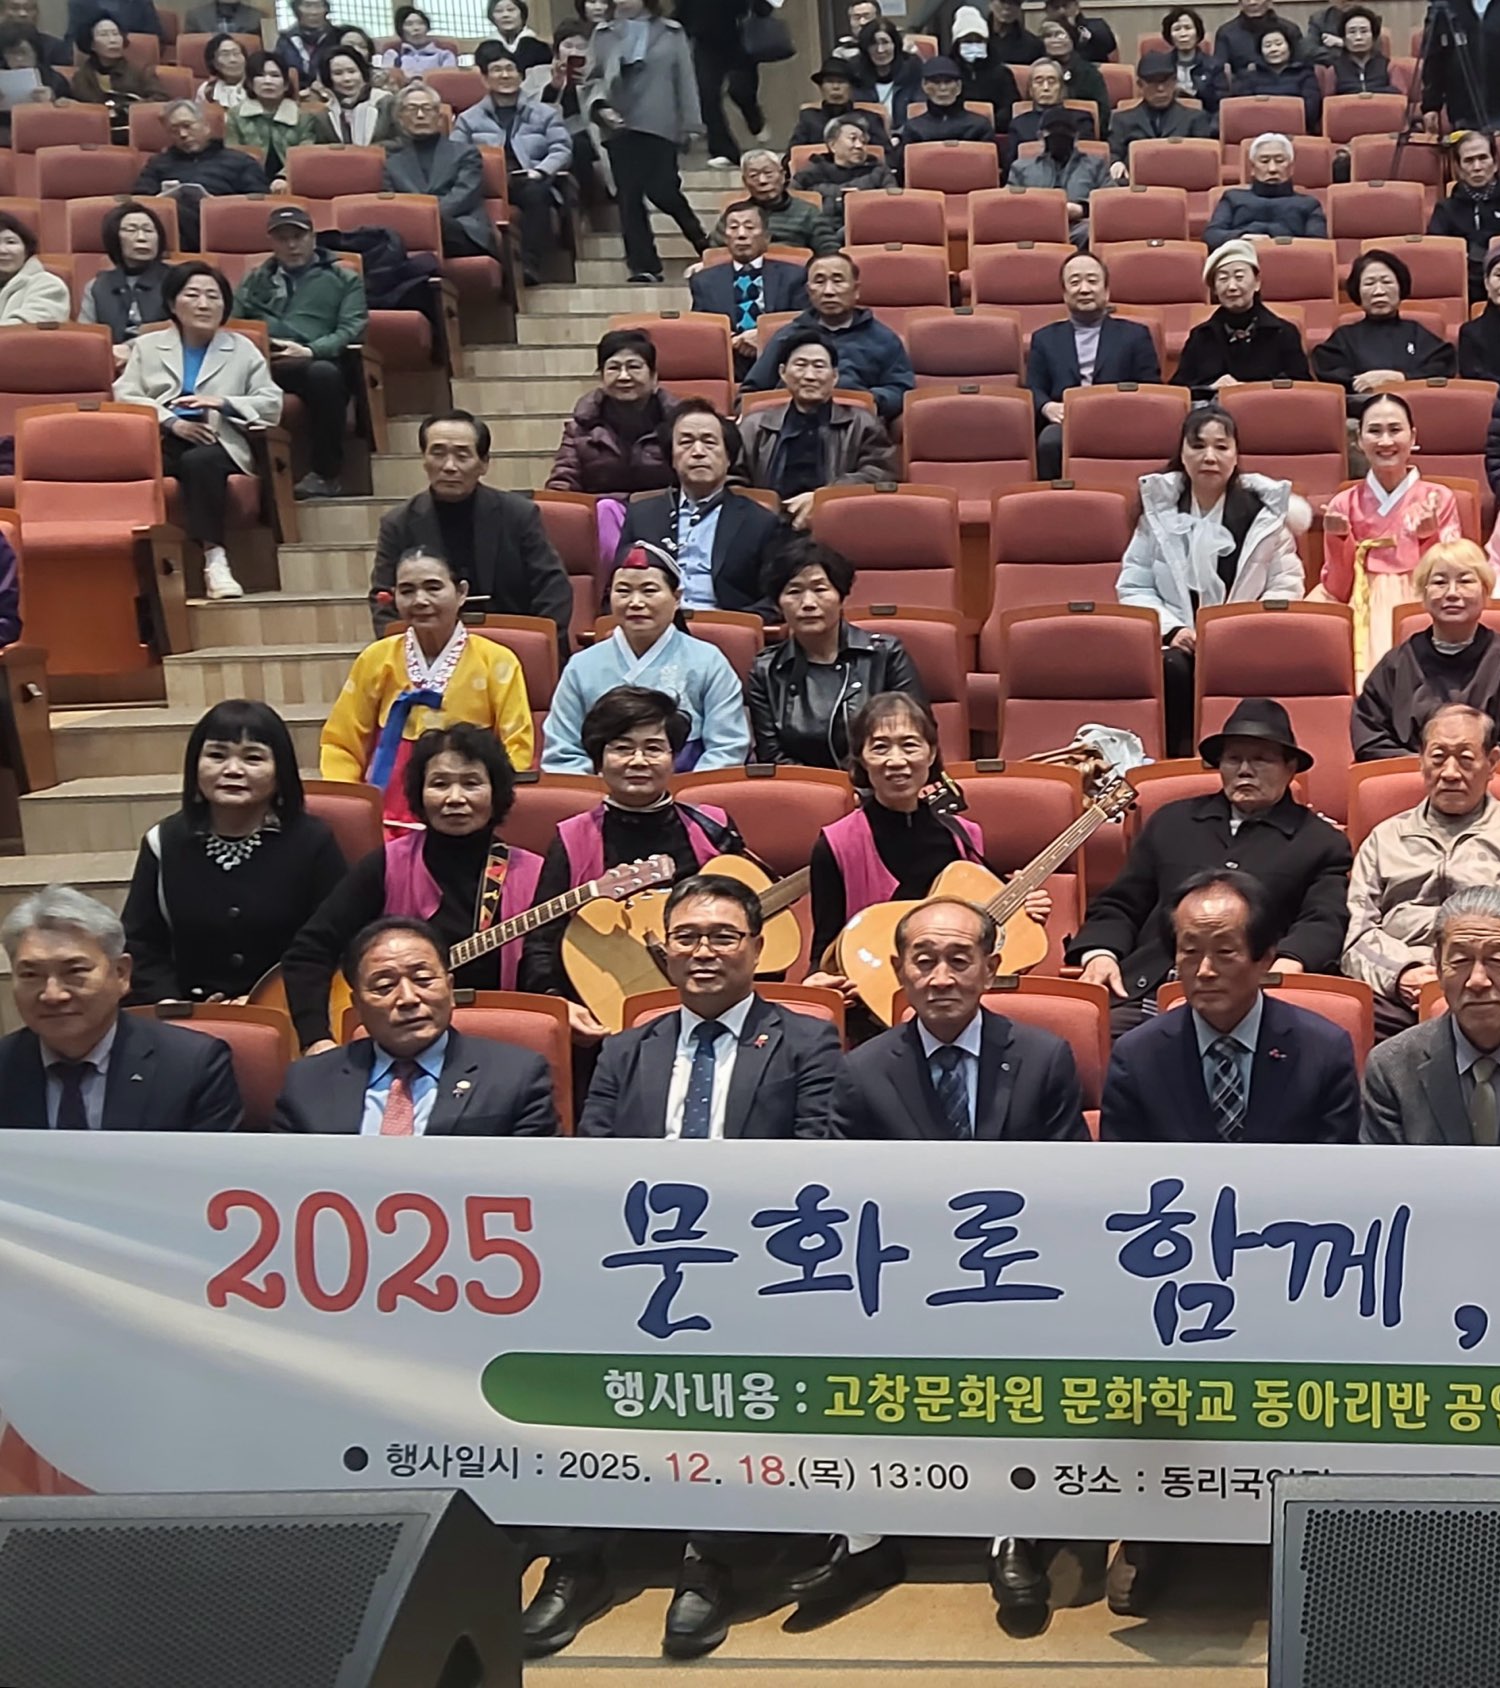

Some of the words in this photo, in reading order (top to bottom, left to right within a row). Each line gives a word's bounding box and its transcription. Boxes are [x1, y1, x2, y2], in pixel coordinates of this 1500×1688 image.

[206, 1188, 542, 1316] 2025
[600, 1179, 1066, 1341] 문화로
[1104, 1177, 1490, 1351] 함께,
[602, 1368, 781, 1421] 행사내용
[822, 1372, 1045, 1425] 고창문화원
[1058, 1375, 1238, 1427] 문화학교
[1251, 1379, 1432, 1430] 동아리반
[385, 1442, 519, 1481] 행사일시
[869, 1462, 970, 1491] 13:00
[1052, 1463, 1123, 1497] 장소
